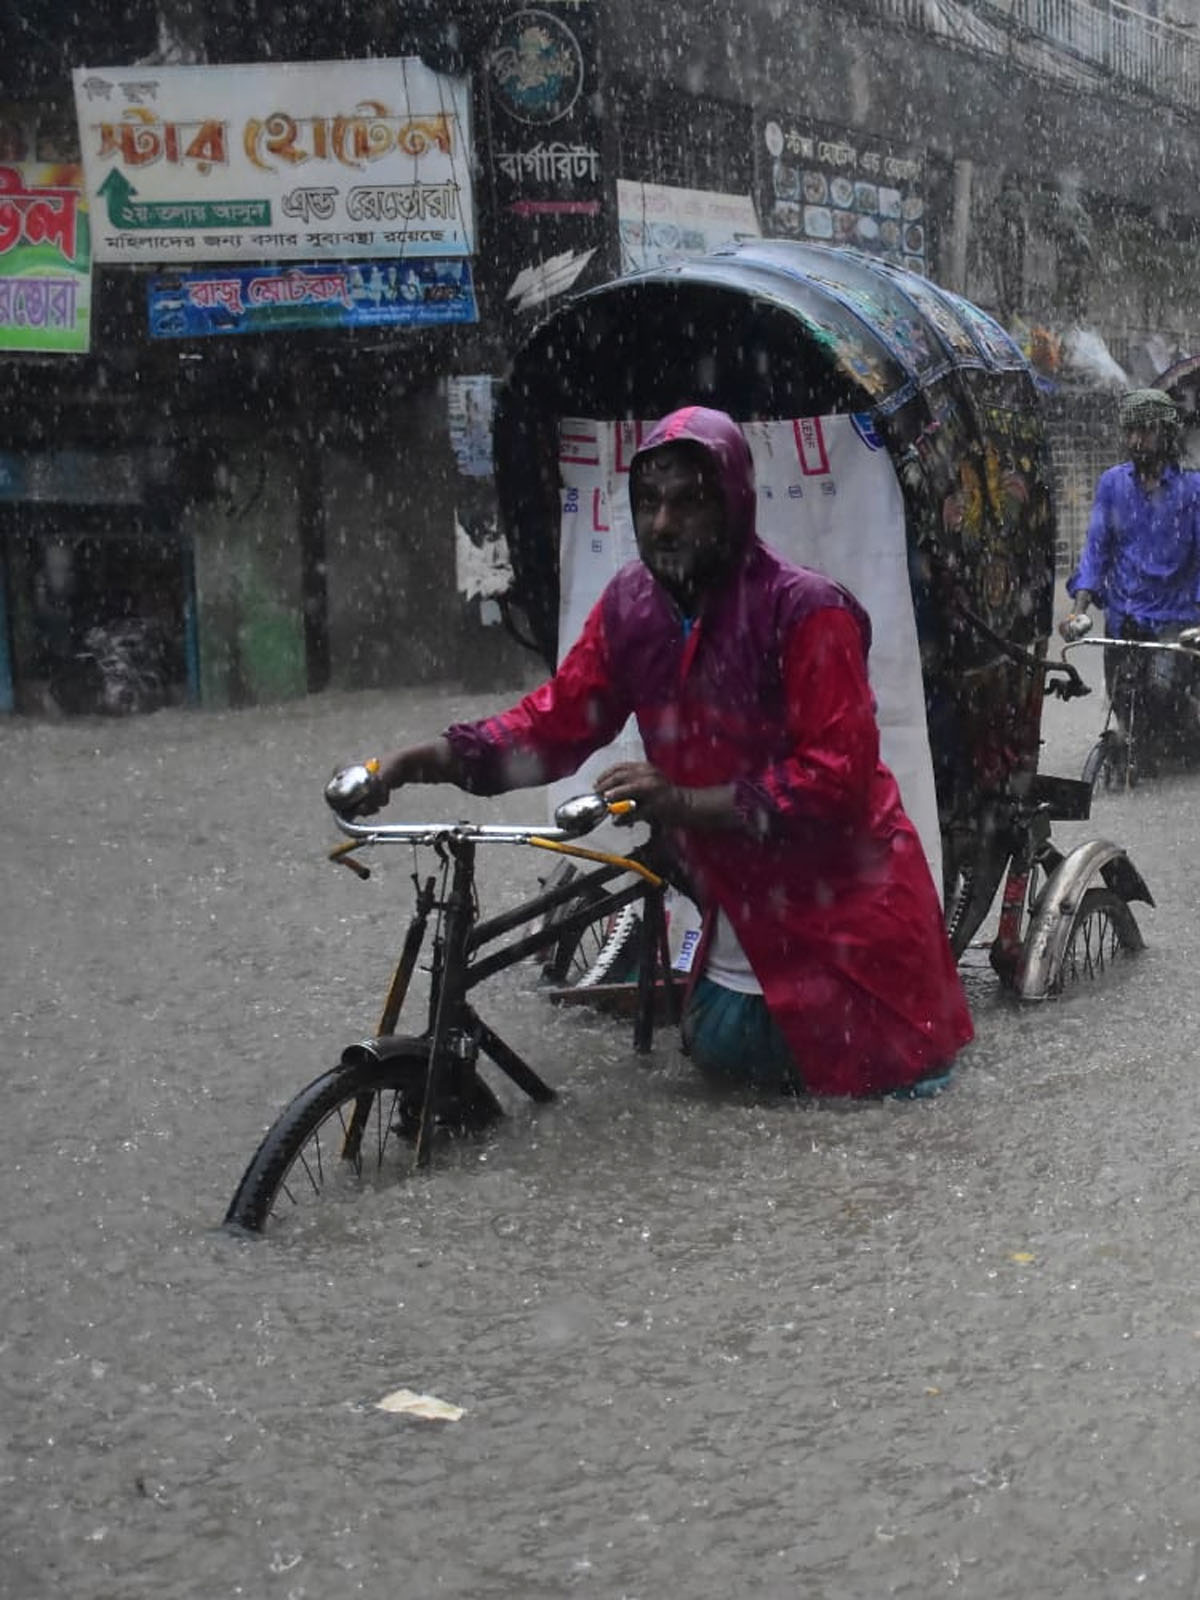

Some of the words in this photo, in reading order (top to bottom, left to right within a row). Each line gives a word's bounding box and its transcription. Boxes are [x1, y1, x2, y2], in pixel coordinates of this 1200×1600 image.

[92, 107, 229, 177] স্টার
[243, 100, 459, 172] হোটেল
[496, 141, 601, 182] বার্গারিটা
[104, 233, 195, 249] মহিলাদের
[203, 234, 243, 247] জন্য
[252, 232, 297, 247] বসার
[384, 231, 446, 243] রয়েছে
